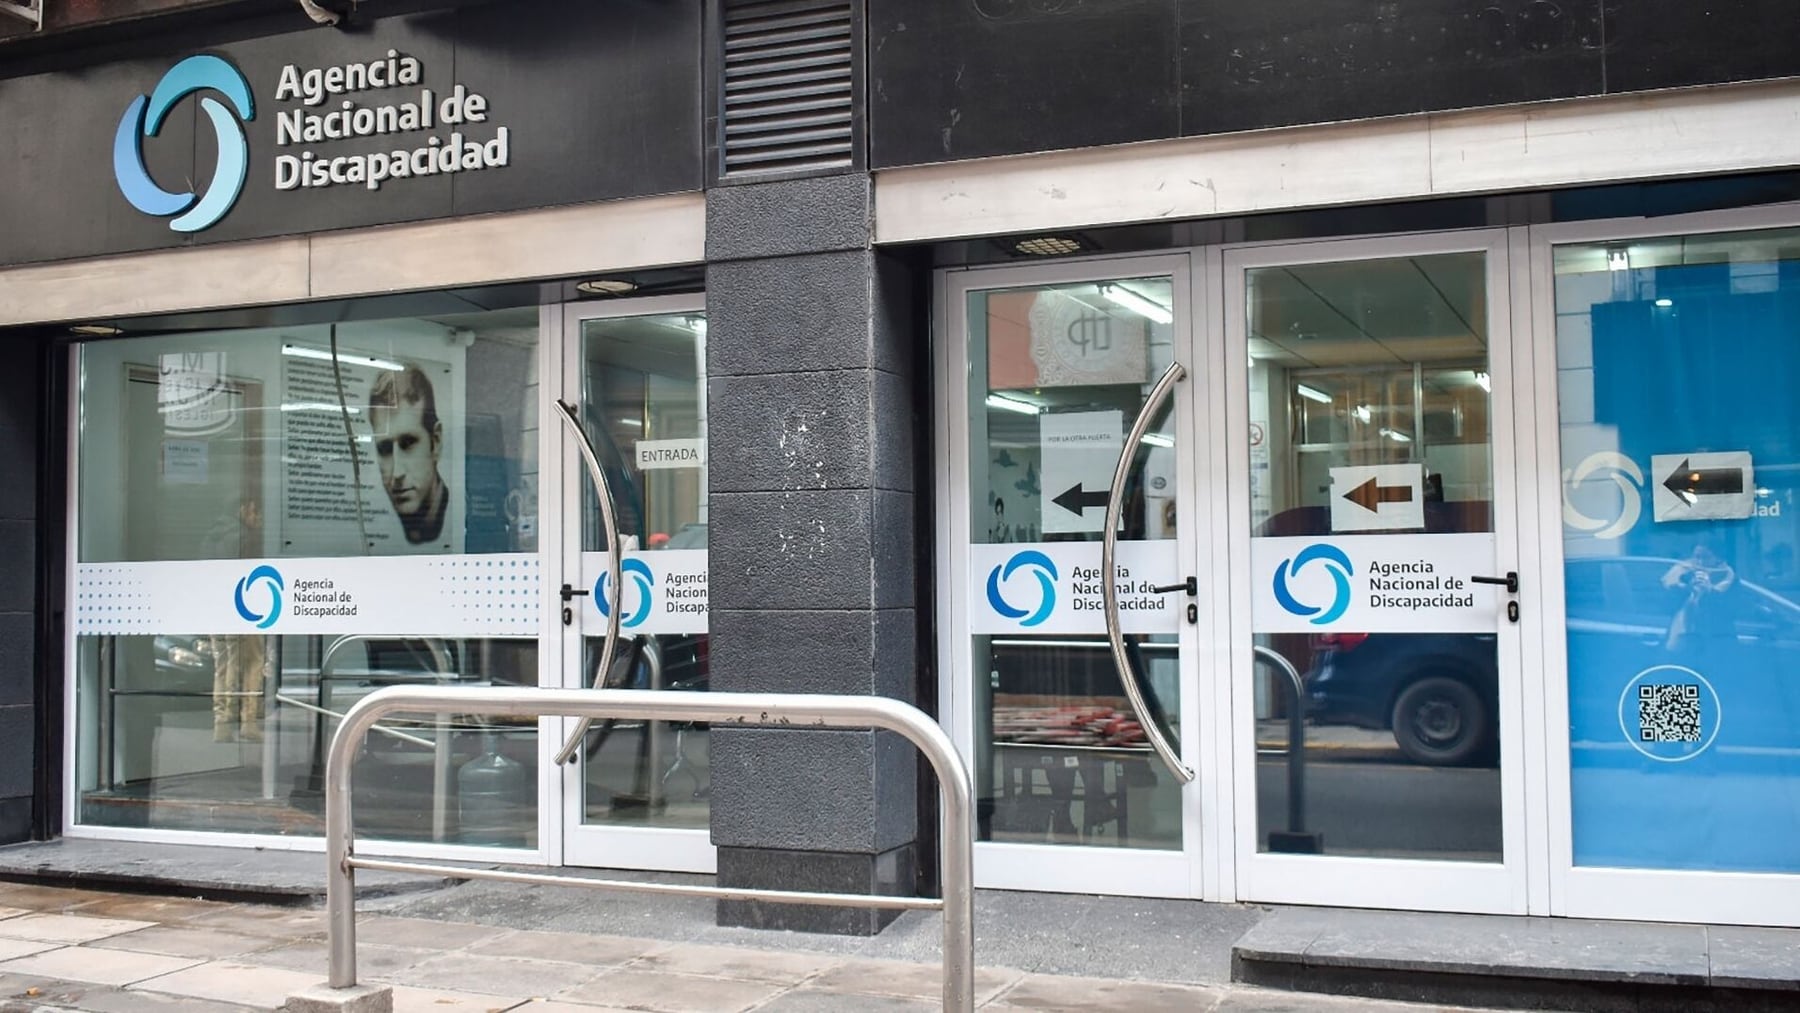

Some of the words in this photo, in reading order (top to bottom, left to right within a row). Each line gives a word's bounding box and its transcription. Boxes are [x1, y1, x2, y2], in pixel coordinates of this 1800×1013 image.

[275, 49, 422, 105] Agencia
[277, 88, 433, 146] Nacional
[440, 84, 487, 126] de
[275, 126, 508, 190] Discapacidad
[641, 448, 699, 463] ENTRADA
[1072, 565, 1129, 582] Ageia
[1369, 560, 1434, 577] Agencia
[293, 578, 334, 592] Agencia
[665, 571, 706, 587] Agenci
[1369, 576, 1440, 591] Nacional
[1444, 576, 1464, 590] de
[666, 586, 707, 599] Nacion
[1073, 581, 1135, 594] Nacinal
[1139, 581, 1156, 594] de
[293, 591, 337, 603] Nacional
[339, 591, 352, 603] de
[1073, 596, 1165, 610] Discacidad
[1369, 593, 1474, 609] Discapacidad
[293, 604, 358, 618] Discapacidad
[666, 600, 710, 615] Discapa
